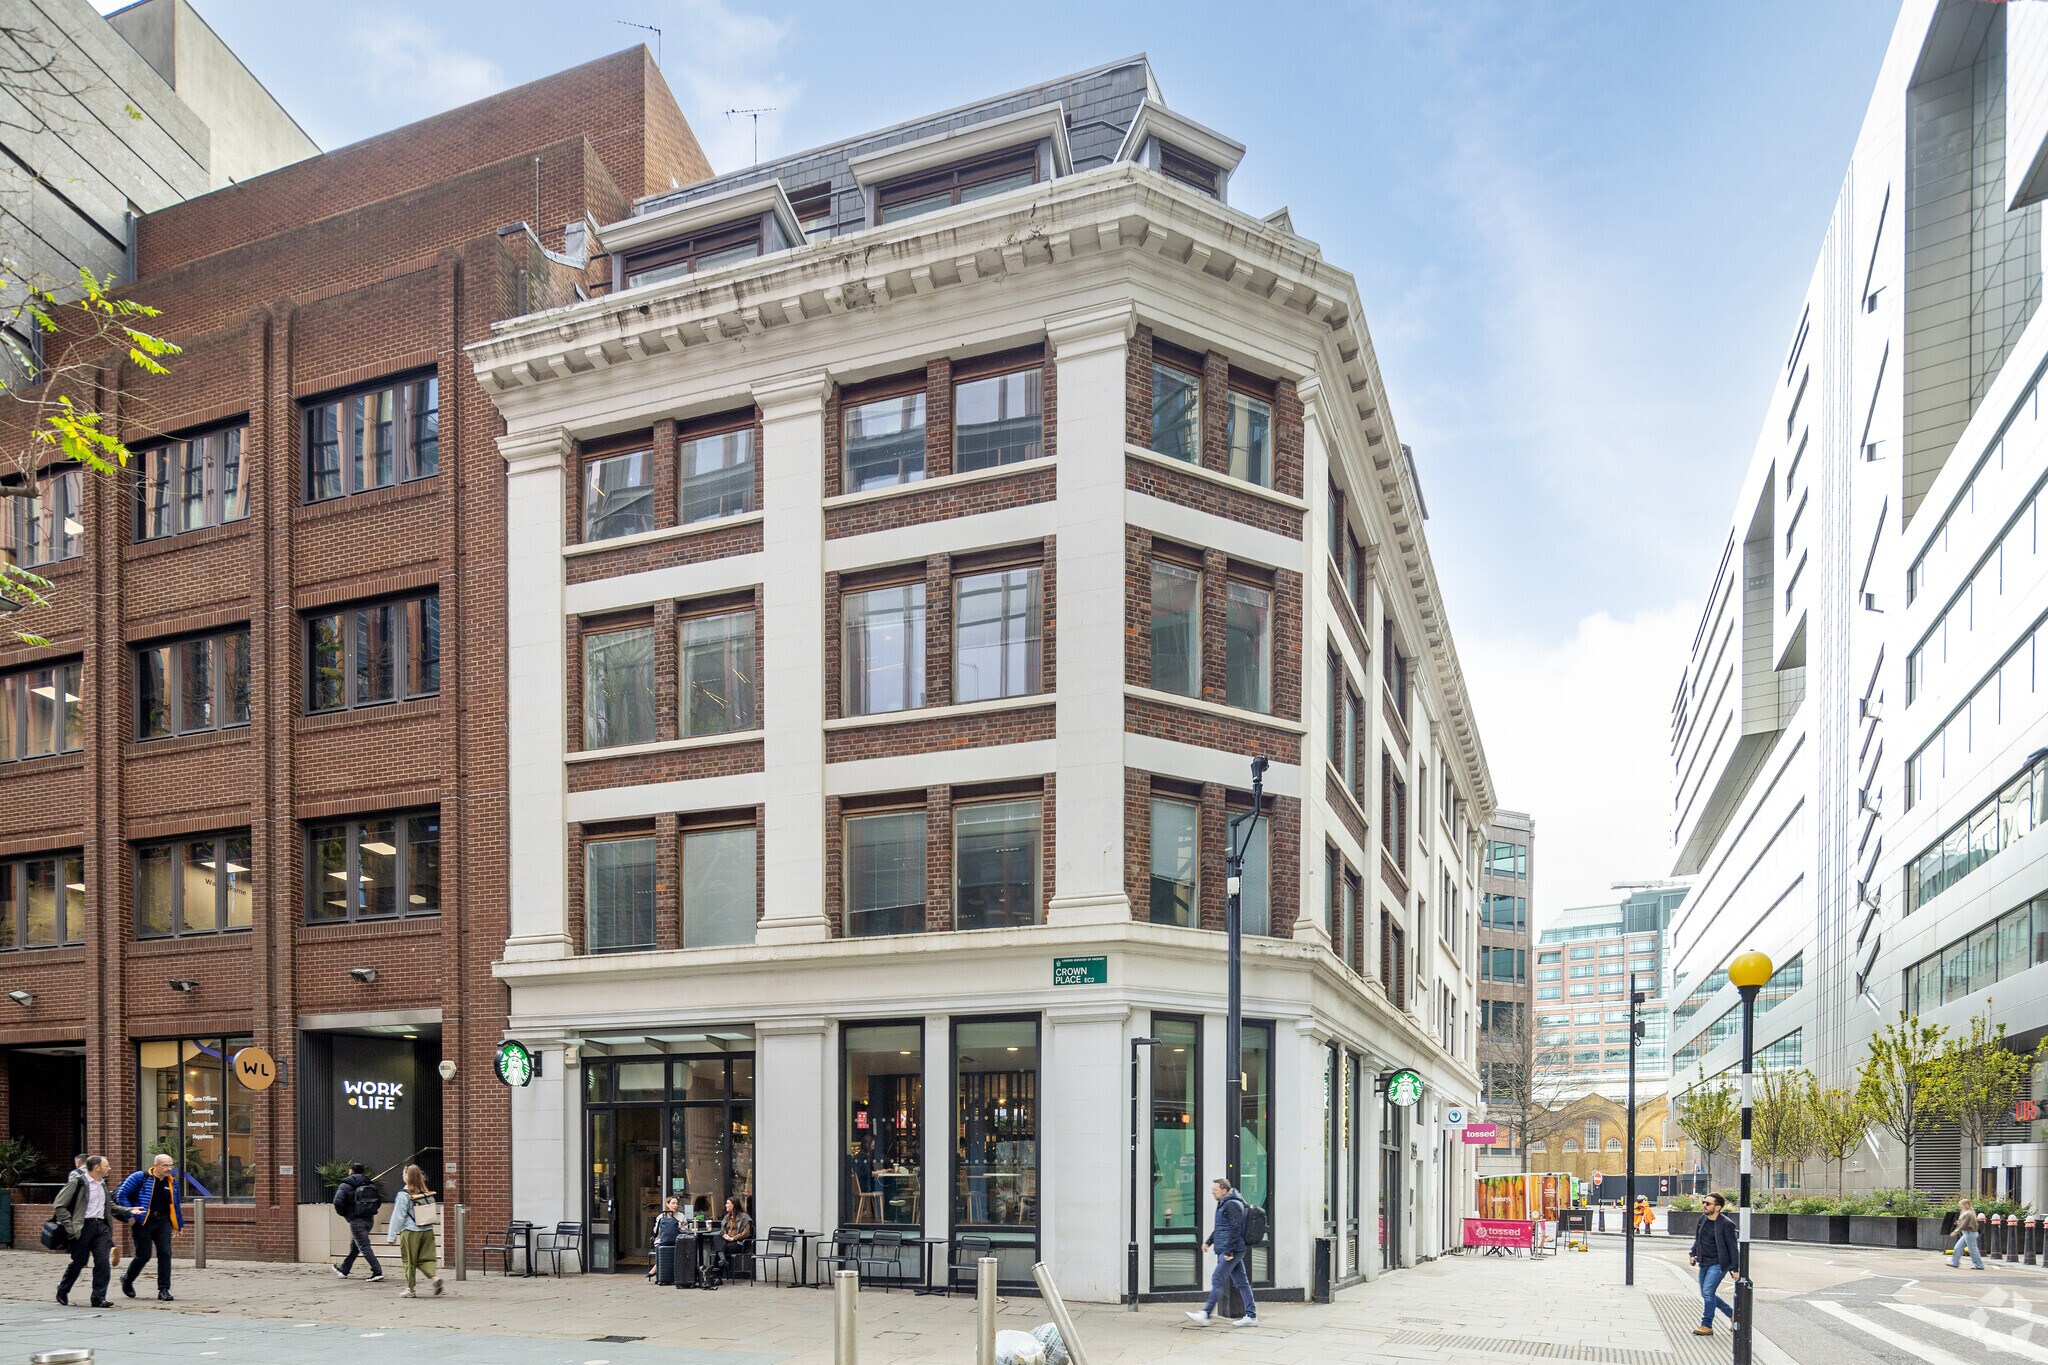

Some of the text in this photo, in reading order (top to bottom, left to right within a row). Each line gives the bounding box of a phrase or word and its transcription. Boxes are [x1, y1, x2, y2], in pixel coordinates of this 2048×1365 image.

[230, 885, 247, 896] Fame
[1055, 967, 1088, 976] CROWN
[1055, 975, 1081, 984] PLACE
[343, 1080, 403, 1096] WORK
[1466, 1130, 1495, 1138] tossed
[1488, 1227, 1521, 1236] tossed
